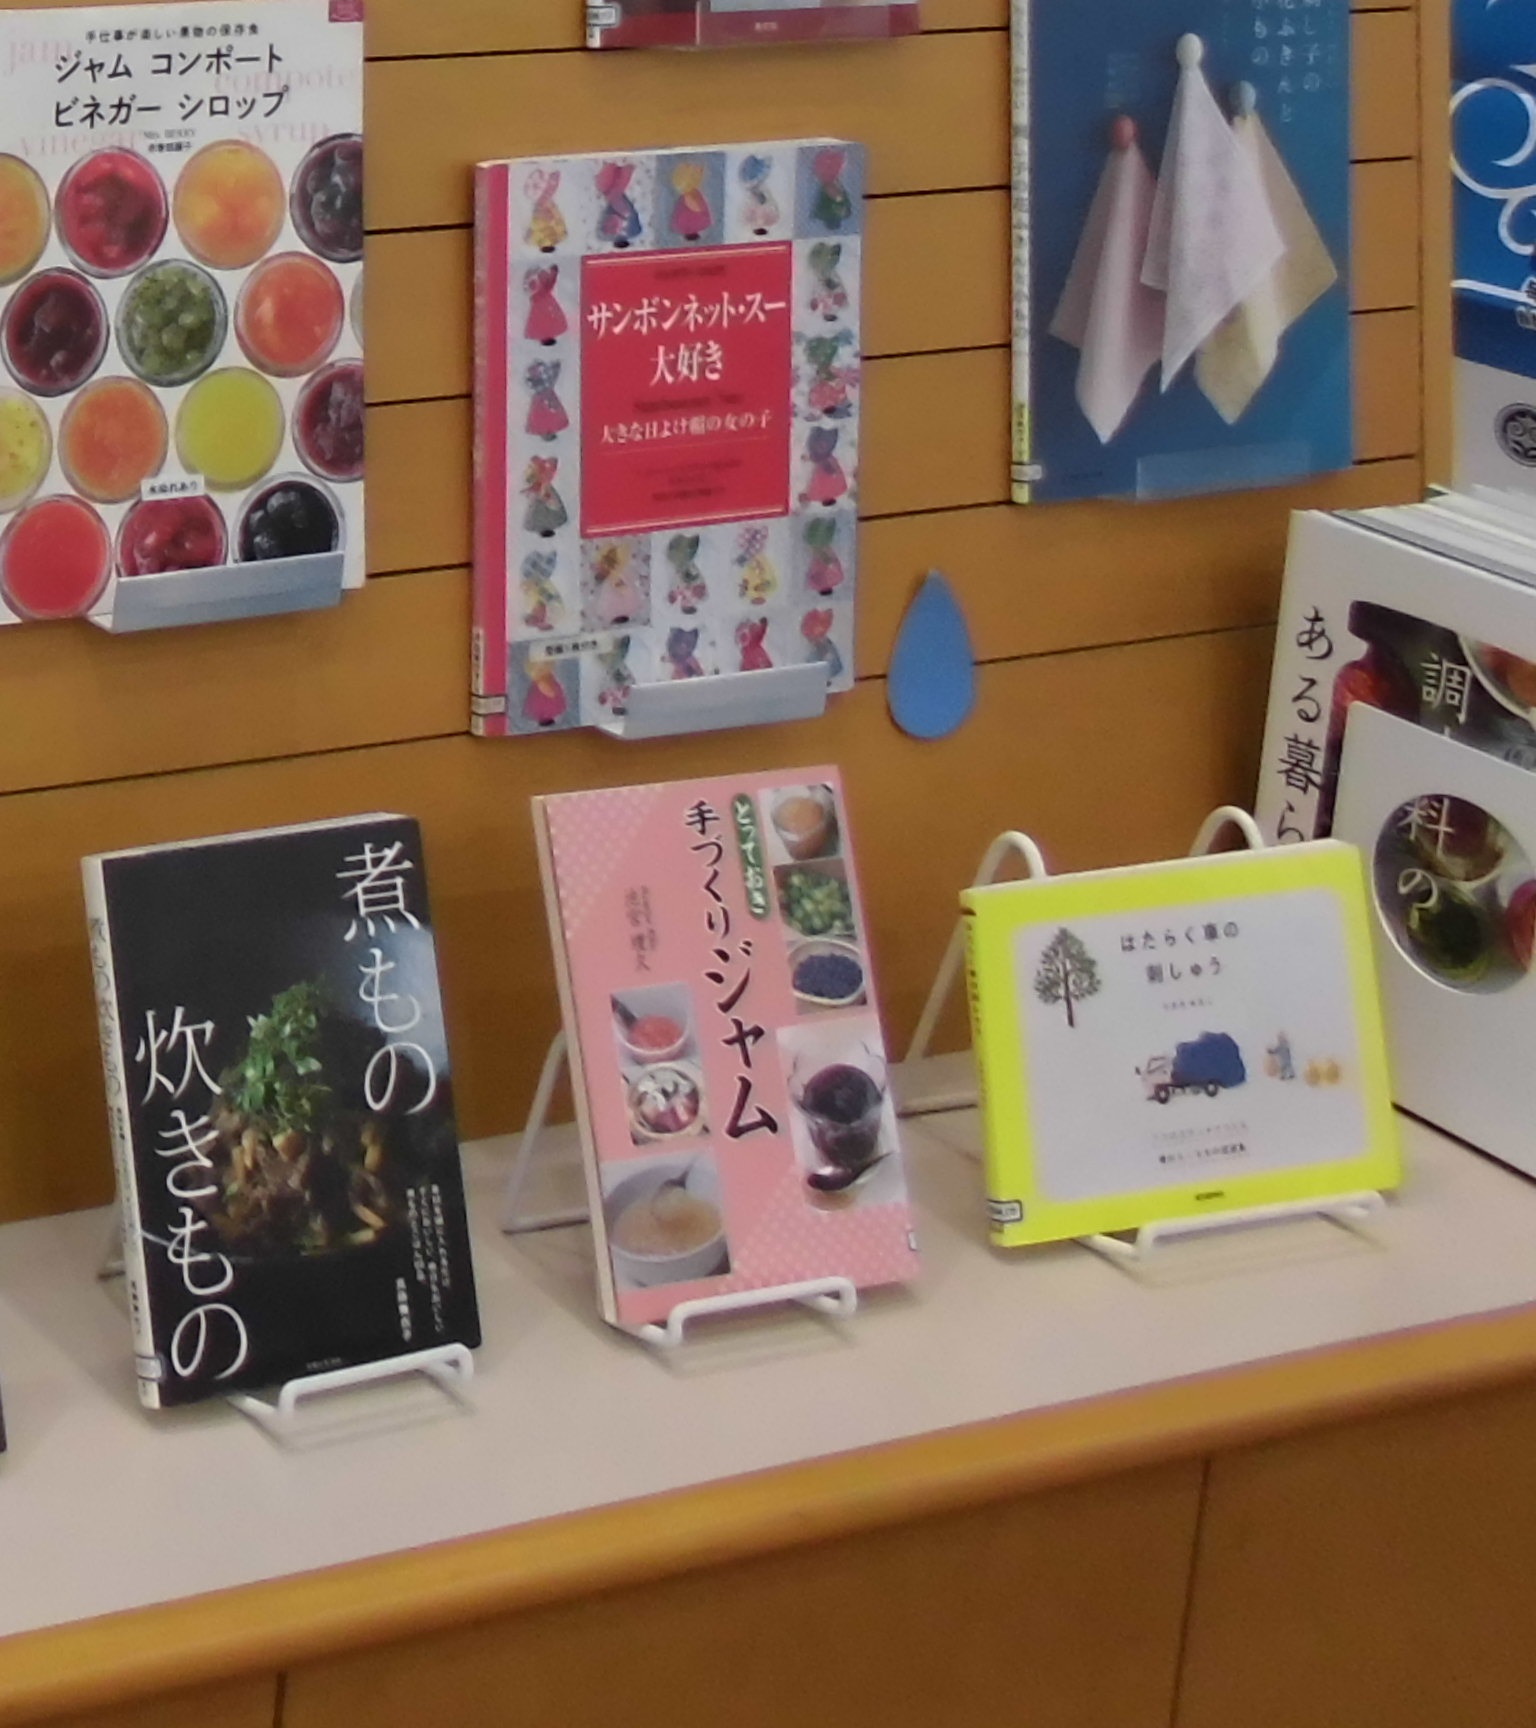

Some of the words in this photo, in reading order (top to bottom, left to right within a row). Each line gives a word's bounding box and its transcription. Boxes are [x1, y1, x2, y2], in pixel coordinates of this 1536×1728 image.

[54, 49, 133, 84] ジャム
[150, 42, 284, 76] コンポート
[53, 94, 162, 129] ビネガー
[178, 84, 290, 122] シロップ
[587, 291, 787, 339] サンボンネット・スー
[649, 341, 724, 386] 大好き
[1420, 652, 1474, 740] 調
[335, 840, 437, 1114] 煮もの
[684, 798, 779, 1141] 手づくりジャム
[134, 1005, 249, 1380] 炊きもの
